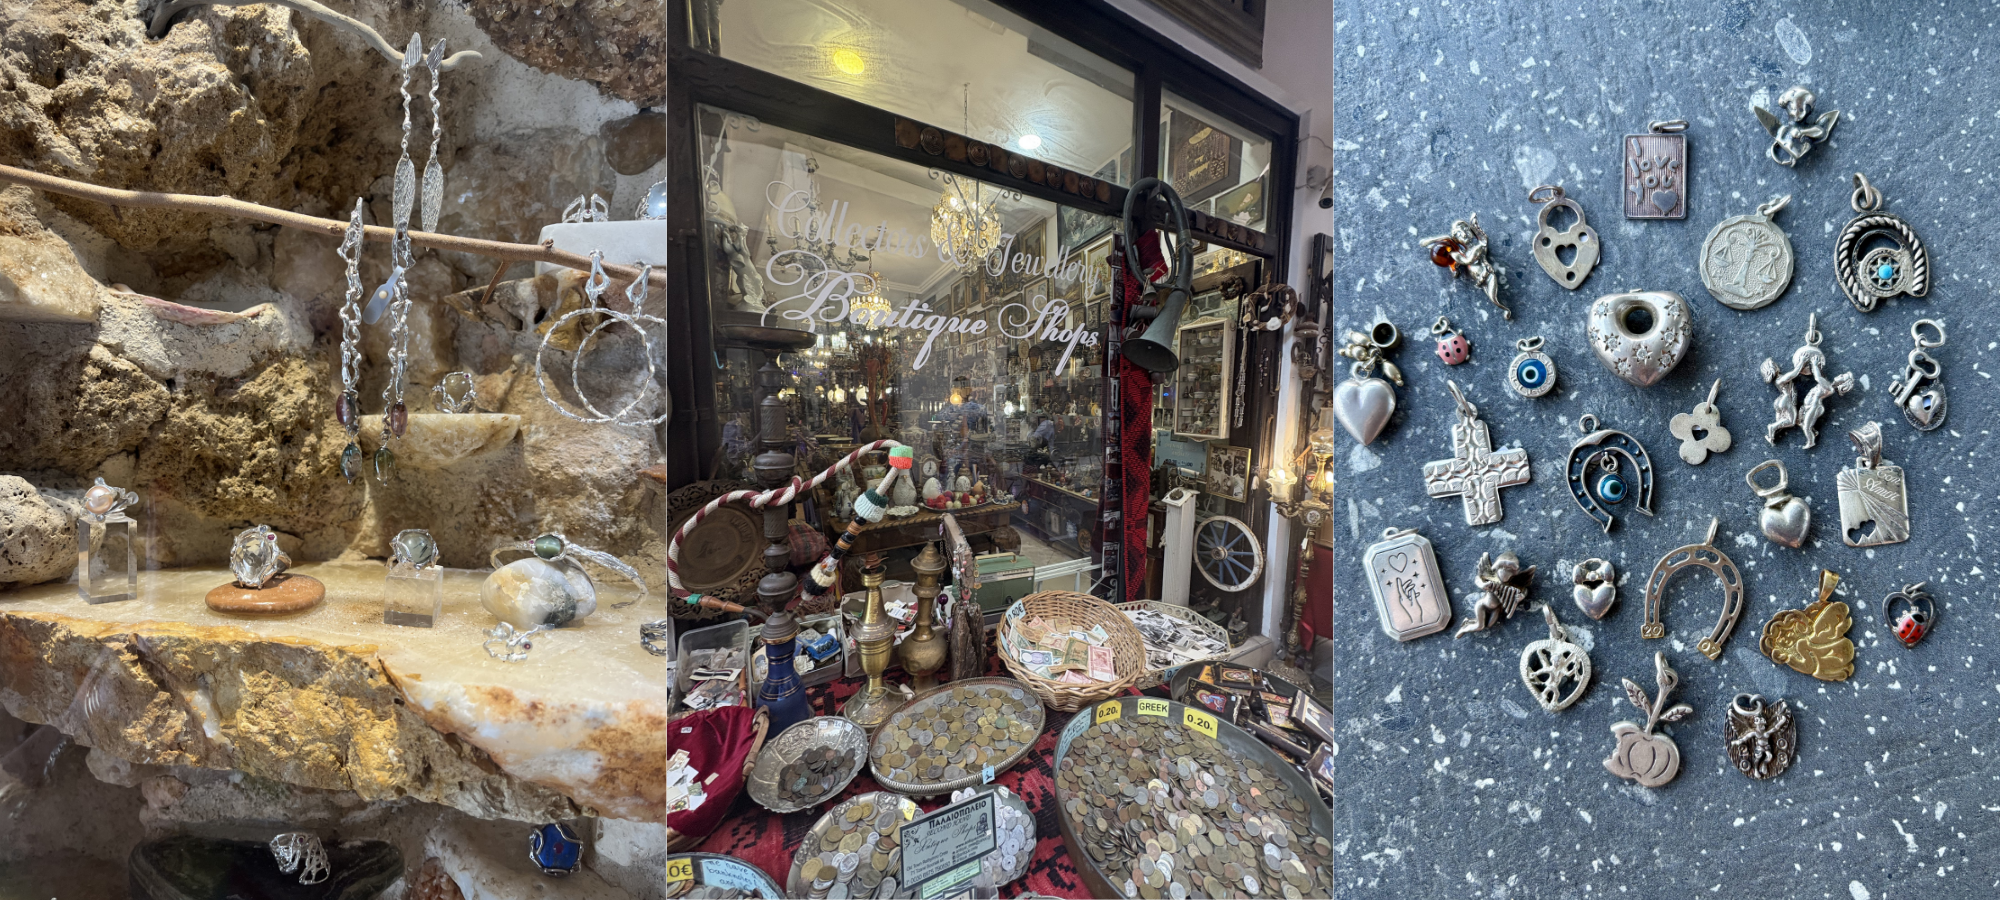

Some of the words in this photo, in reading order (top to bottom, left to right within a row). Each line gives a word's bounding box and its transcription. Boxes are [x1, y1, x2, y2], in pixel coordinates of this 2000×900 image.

[1631, 138, 1641, 157] I
[1629, 155, 1680, 178] love
[1629, 175, 1674, 205] you
[766, 180, 930, 259] Collectors
[937, 220, 973, 267] &
[985, 232, 1100, 299] Jewellery
[761, 249, 989, 371] Boutique
[997, 294, 1100, 377] Shops
[1643, 625, 1662, 637] 20
[1138, 702, 1168, 713] GREEK
[928, 800, 987, 829] ΠΑΛΑΙΟΠΩΛΕΙΟ
